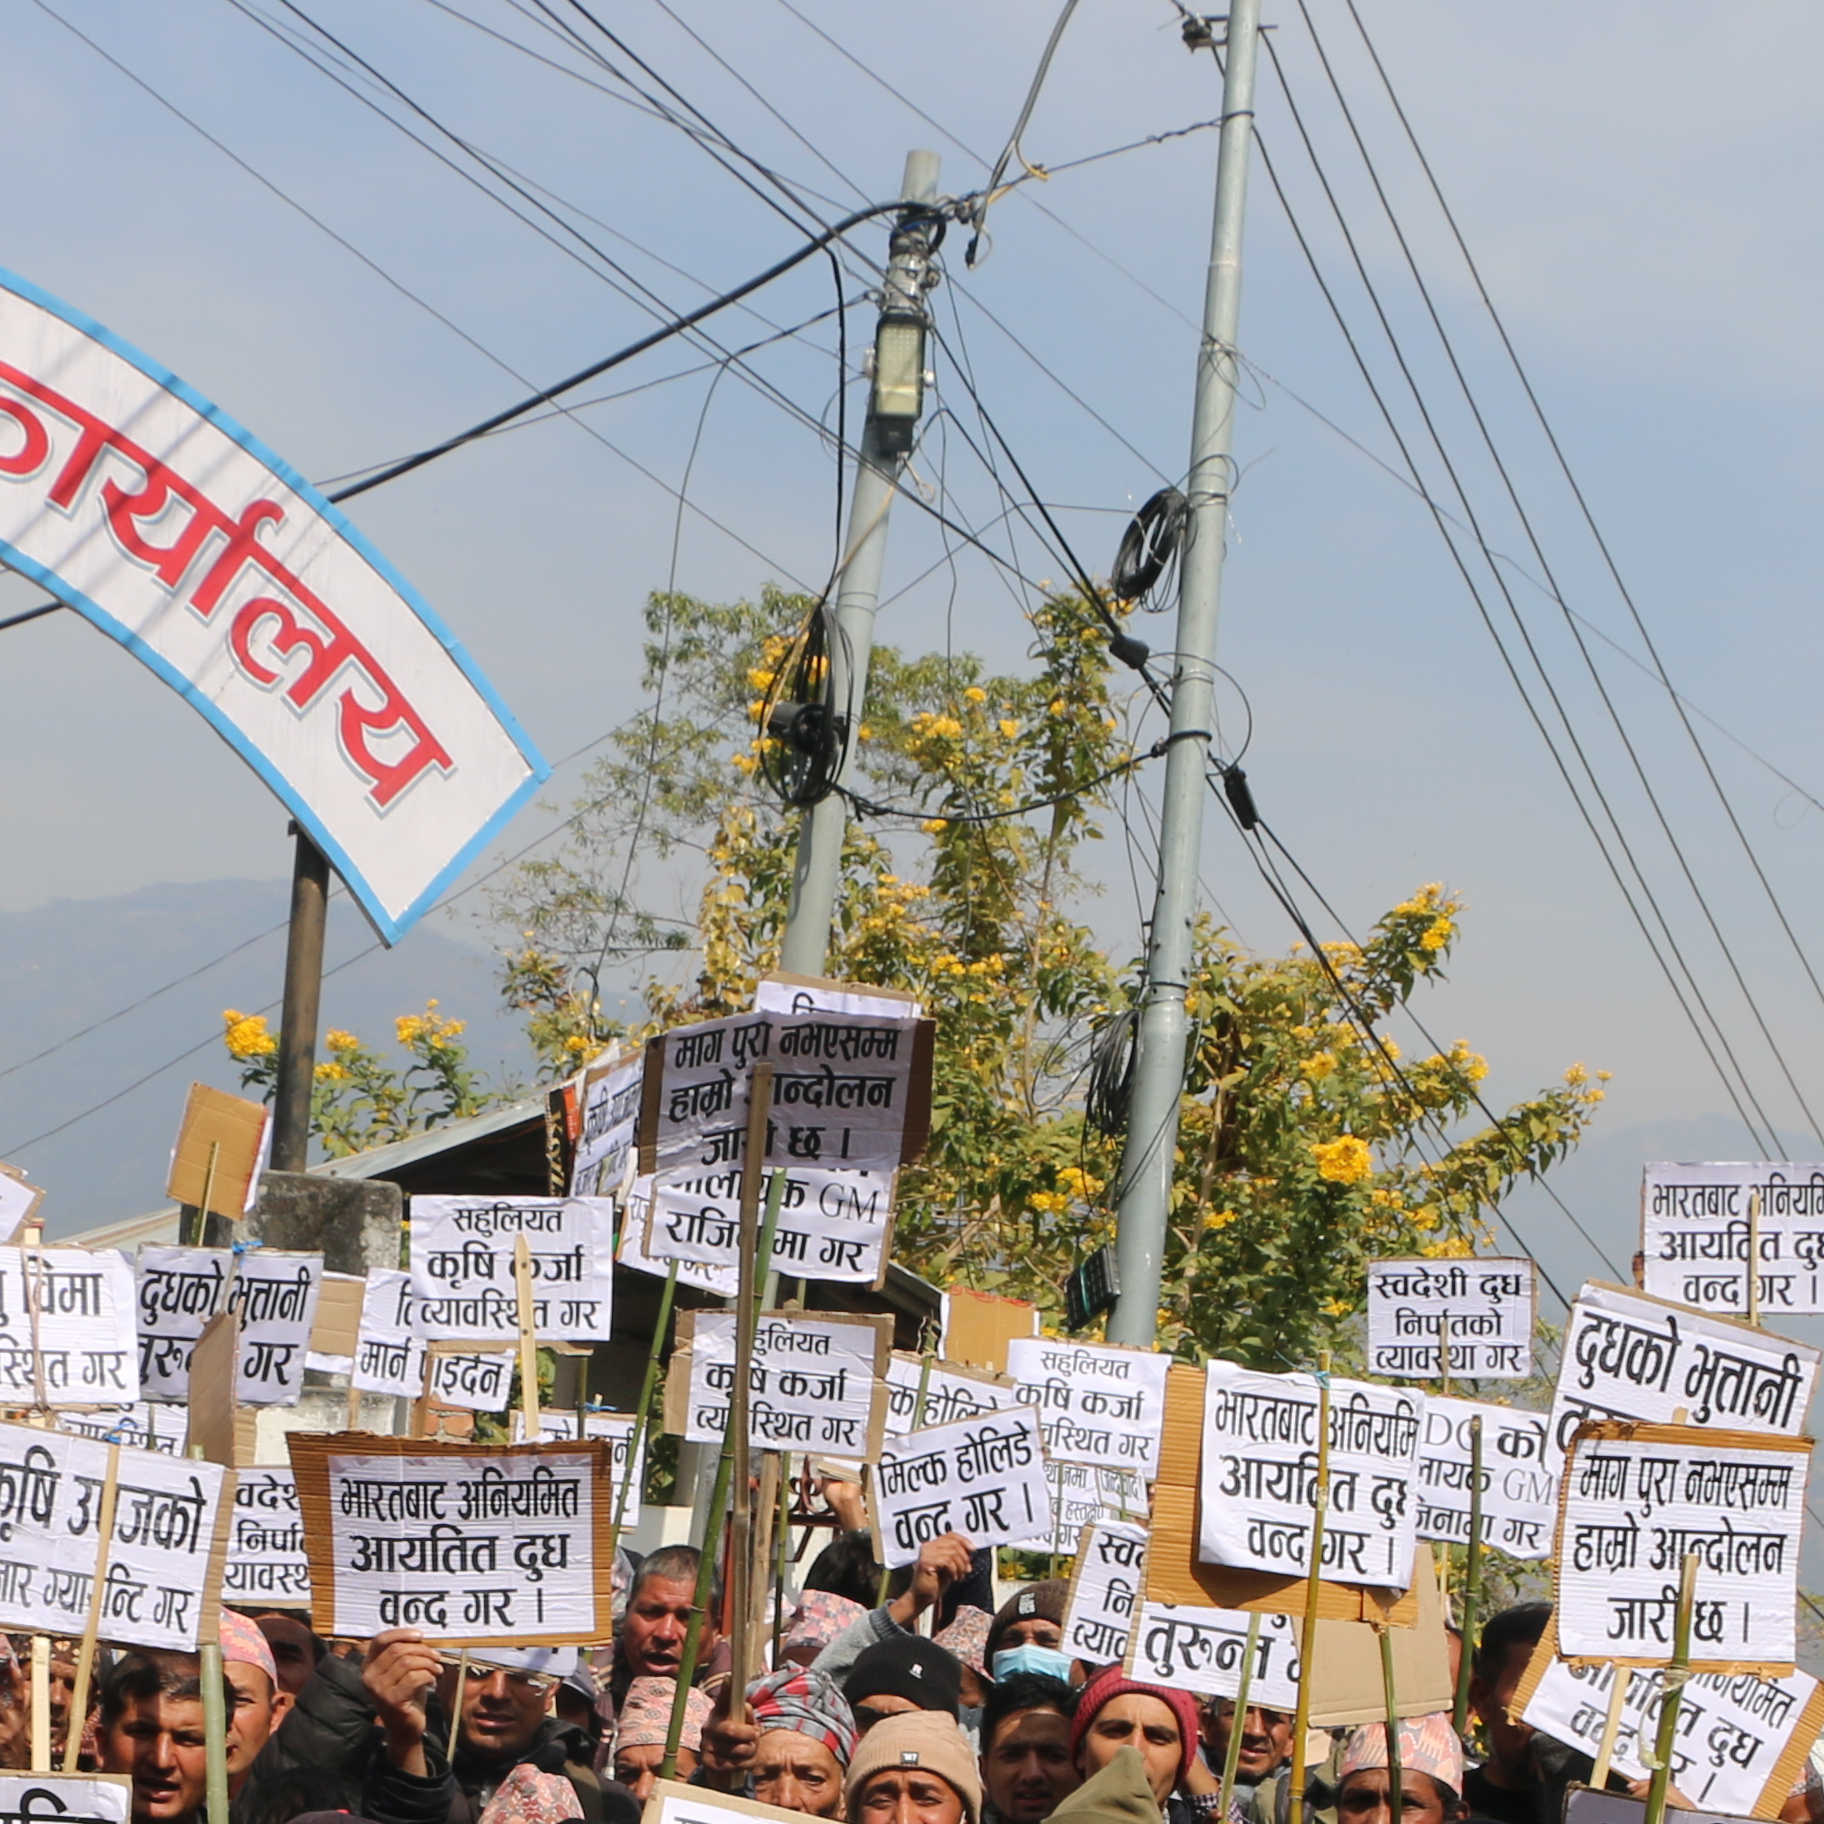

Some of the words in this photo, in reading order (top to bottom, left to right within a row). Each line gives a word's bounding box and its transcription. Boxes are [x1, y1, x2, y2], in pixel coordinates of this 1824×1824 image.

[674, 1027, 725, 1068] माग
[732, 1022, 771, 1073] पुरा
[780, 1024, 900, 1061] नभएसम्म
[671, 1072, 733, 1123] हाम्रो
[451, 1202, 563, 1238] सहुलियत
[818, 1183, 878, 1224] GM
[1652, 1182, 1741, 1219] भारतबाट
[426, 1240, 495, 1290] कृषि
[820, 1238, 869, 1272] गर
[1375, 1266, 1467, 1300] स्वदेशी
[1479, 1272, 1522, 1305] दुध
[558, 1300, 602, 1331] गर
[81, 1349, 127, 1389] गर
[244, 1342, 293, 1385] गर
[1039, 1349, 1131, 1379] सहुलियत
[1485, 1345, 1522, 1372] गर
[1576, 1310, 1681, 1392] दुधको
[779, 1364, 848, 1401] कर्जा
[1015, 1378, 1070, 1426] कृषि
[1080, 1386, 1144, 1421] कर्जा
[821, 1412, 860, 1448] गर
[1214, 1390, 1318, 1443] भारतबाट
[878, 1446, 948, 1498] मिल्क
[955, 1421, 1032, 1483] होलिडे
[1117, 1432, 1154, 1461] गर
[340, 1478, 447, 1521] भारतबाट
[457, 1466, 580, 1519] अनियमित
[1579, 1455, 1631, 1500] माग
[1639, 1456, 1682, 1520] पुरा
[1684, 1460, 1793, 1510] नभएसम्म
[964, 1493, 1018, 1535] गर
[513, 1534, 571, 1582] दुध
[1320, 1525, 1371, 1575] गर
[1574, 1512, 1639, 1581] हाम्रो
[1648, 1517, 1788, 1578] आन्दोलन
[153, 1586, 196, 1635] गर
[379, 1590, 450, 1629] वन्द
[463, 1588, 518, 1627] गर
[1692, 1600, 1728, 1643] छ
